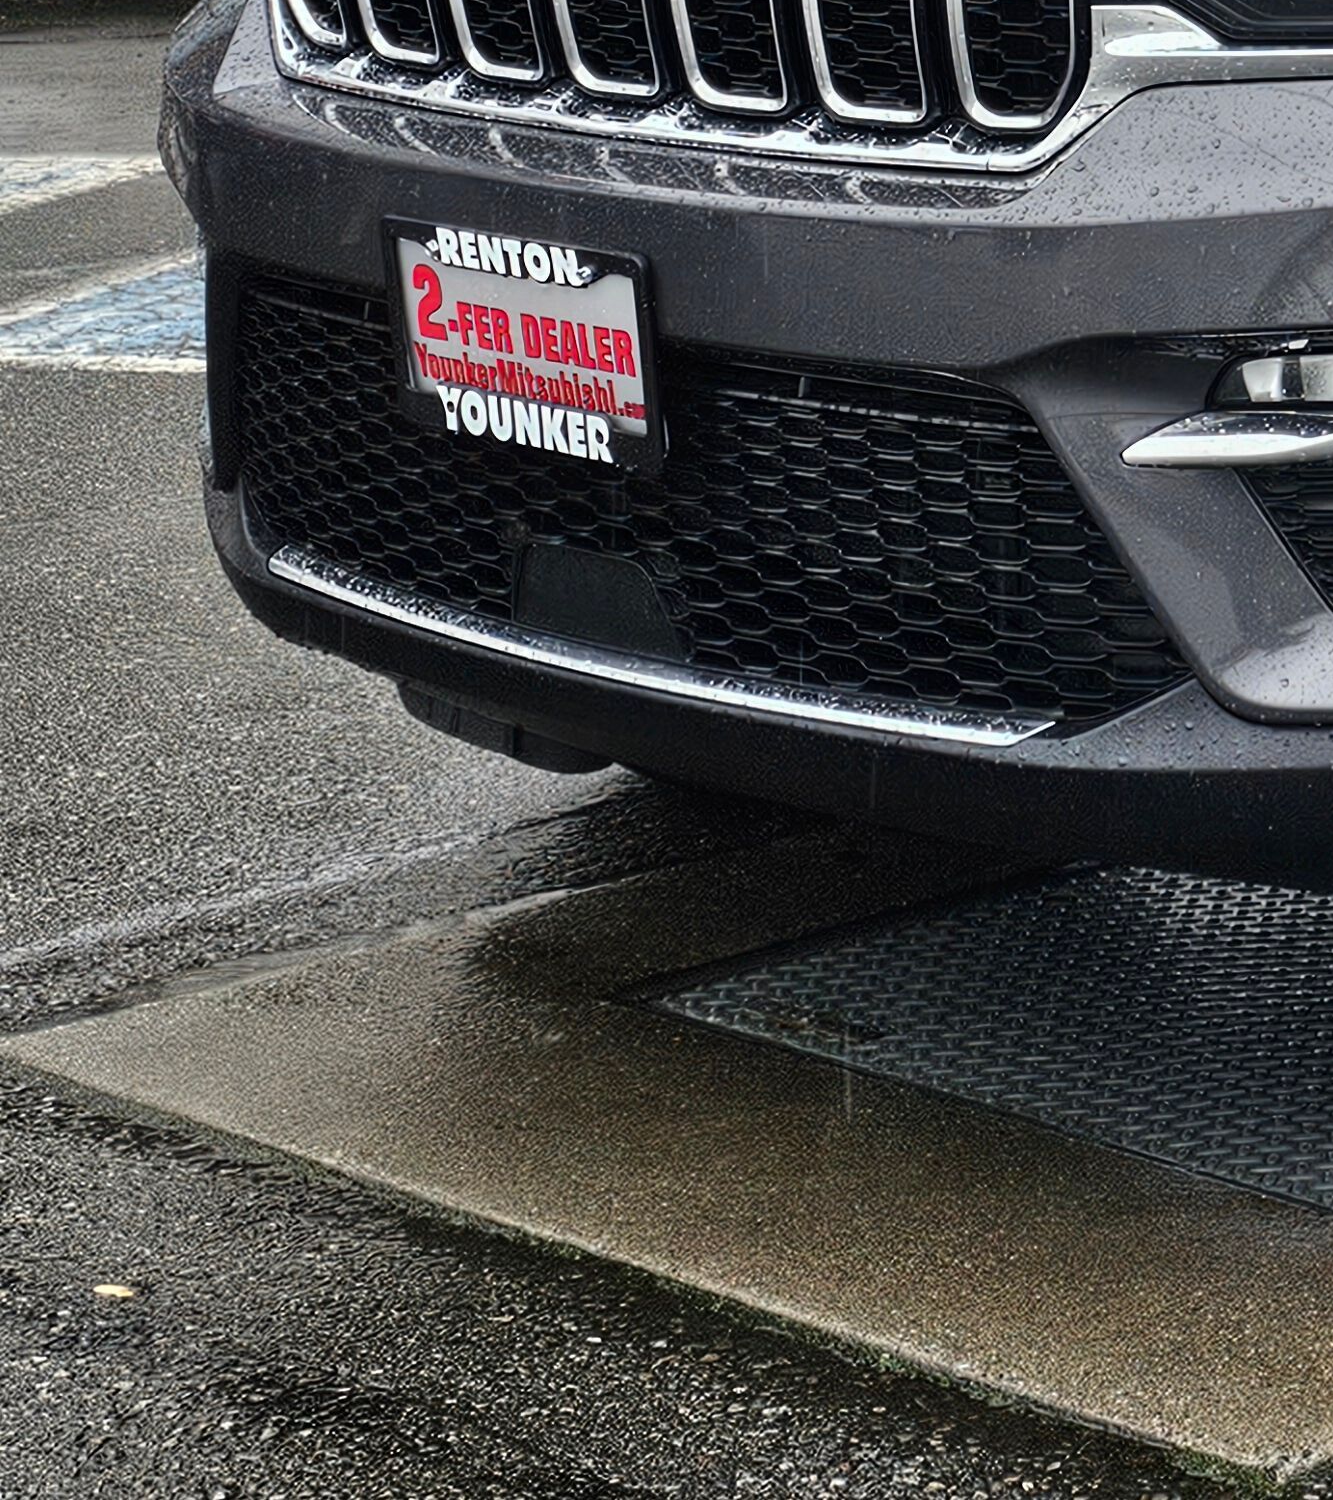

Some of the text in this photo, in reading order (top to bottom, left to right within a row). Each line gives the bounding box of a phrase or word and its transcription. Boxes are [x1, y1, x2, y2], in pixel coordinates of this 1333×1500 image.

[436, 227, 584, 287] RENTON
[412, 264, 637, 378] 2-FER DEALER
[436, 384, 614, 463] YOUNKER
